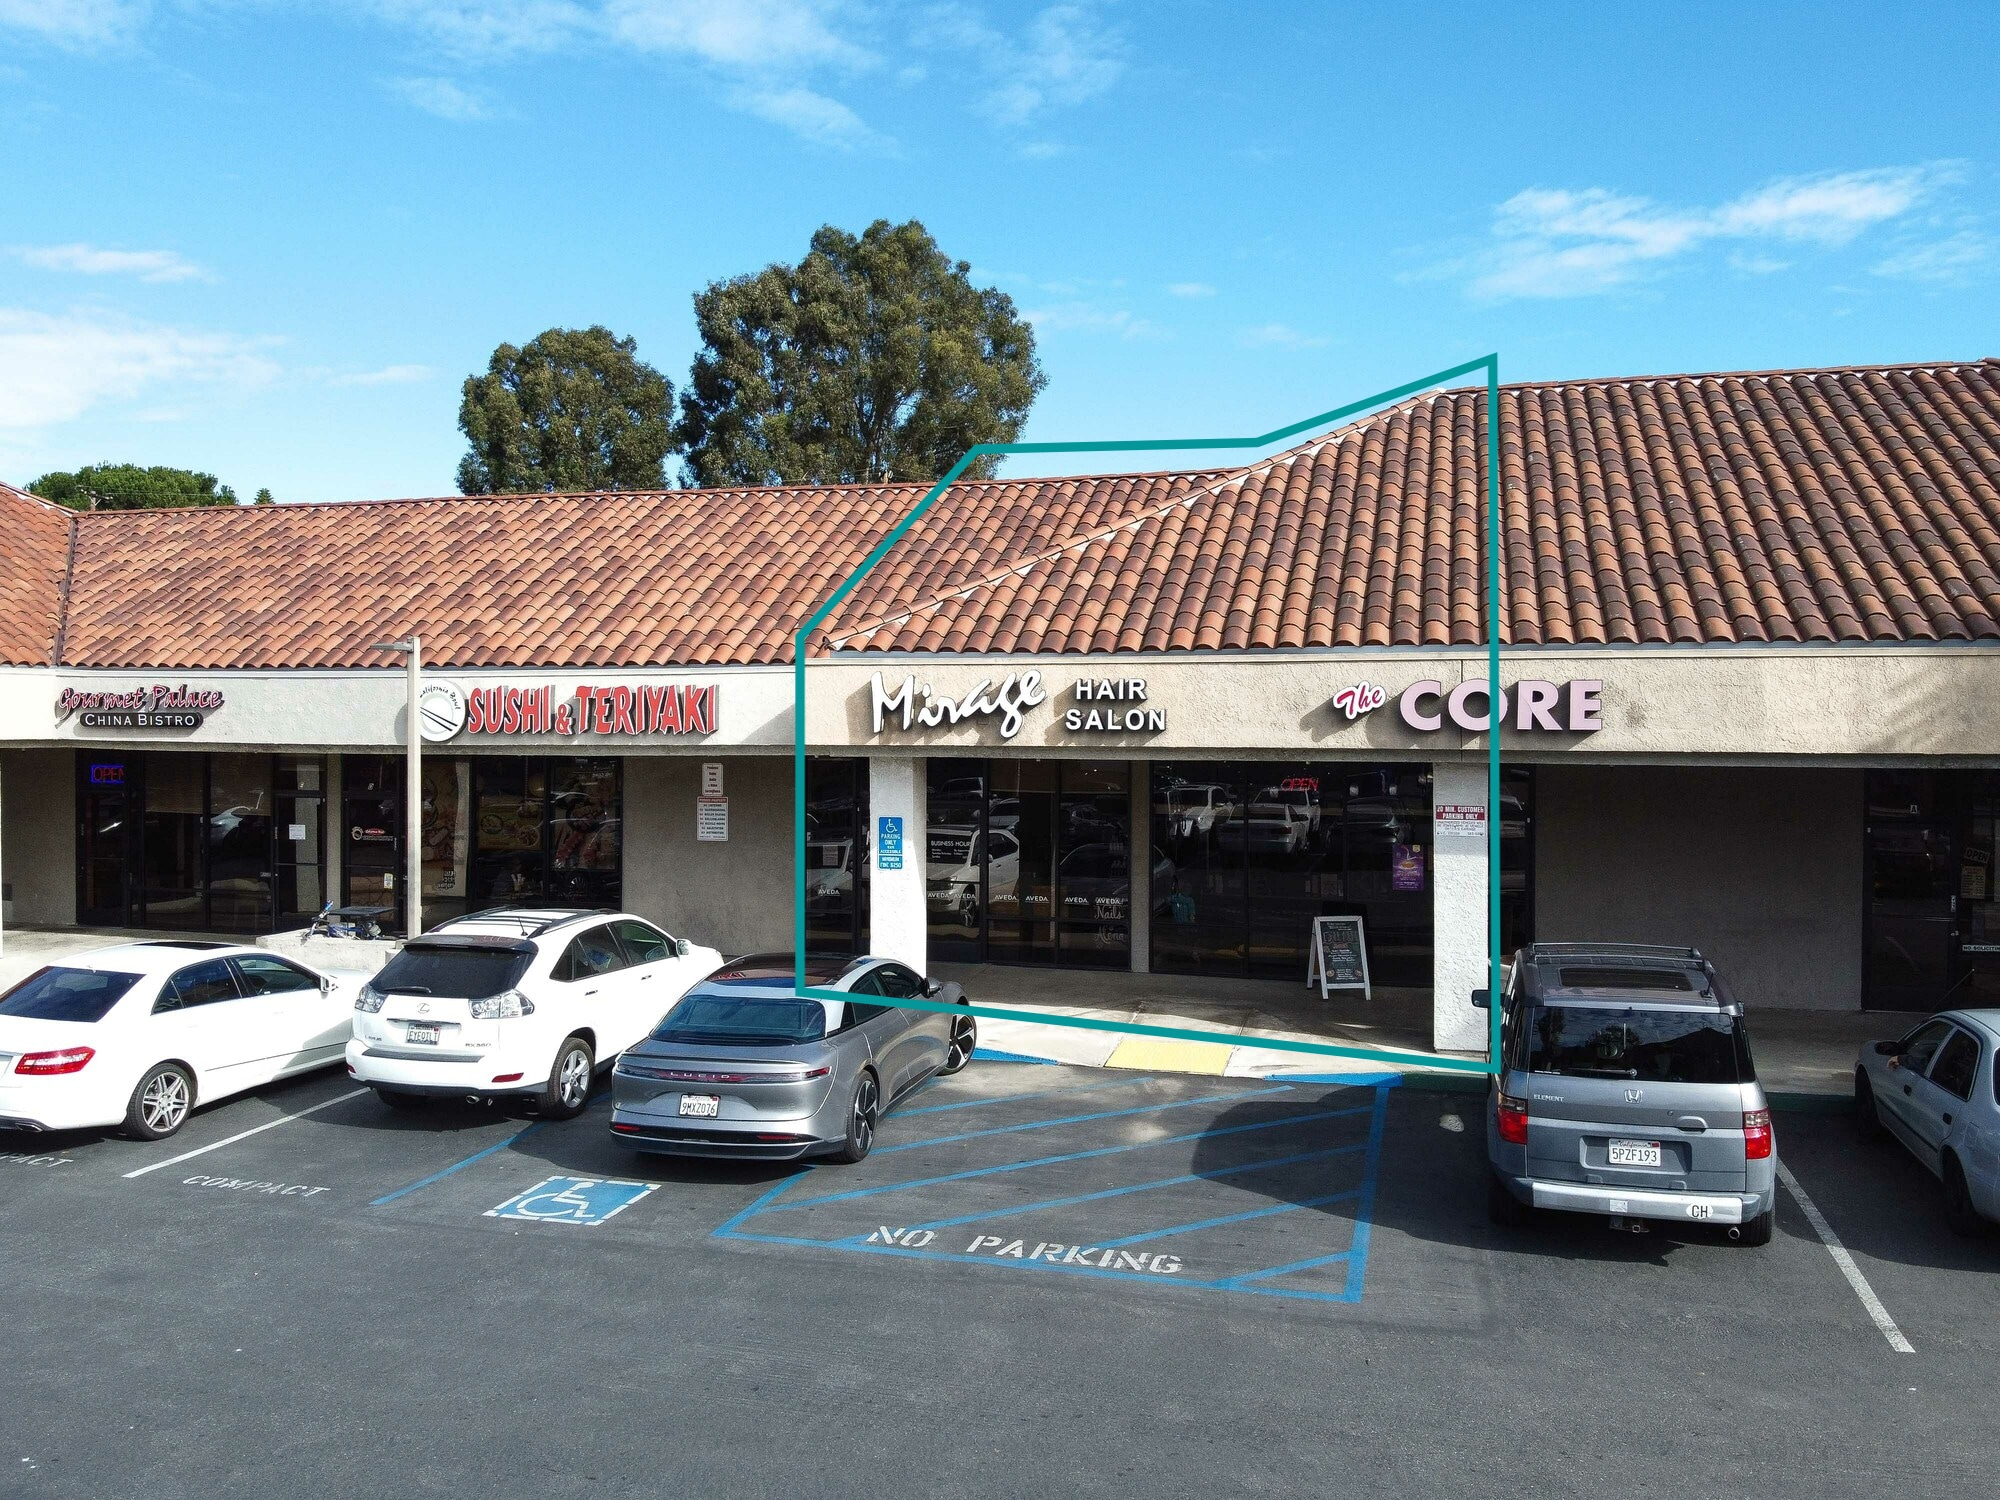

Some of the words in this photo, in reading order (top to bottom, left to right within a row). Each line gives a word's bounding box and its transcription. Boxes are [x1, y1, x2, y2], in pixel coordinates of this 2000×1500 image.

[1075, 678, 1148, 700] HAIR
[58, 687, 145, 720] Gourmet
[149, 684, 224, 711] Palace
[468, 685, 551, 734] SUSHI
[555, 704, 573, 735] &
[575, 685, 716, 735] TERIYAKI
[870, 669, 1046, 738] Mirage
[1334, 681, 1386, 719] The
[1400, 679, 1603, 731] CORE
[85, 714, 132, 726] CHINA
[138, 714, 195, 726] BISTRO
[1065, 708, 1166, 731] SALON
[1281, 777, 1319, 791] OPEN
[1095, 905, 1124, 919] Nails
[682, 1102, 716, 1114] 9MXZ076
[1534, 1094, 1564, 1102] ELEMENT
[1612, 1148, 1657, 1163] 5PZF193
[183, 1175, 332, 1197] COMPACT
[1691, 1205, 1708, 1218] CH
[866, 1226, 936, 1247] NO
[966, 1235, 1182, 1273] PARKING
